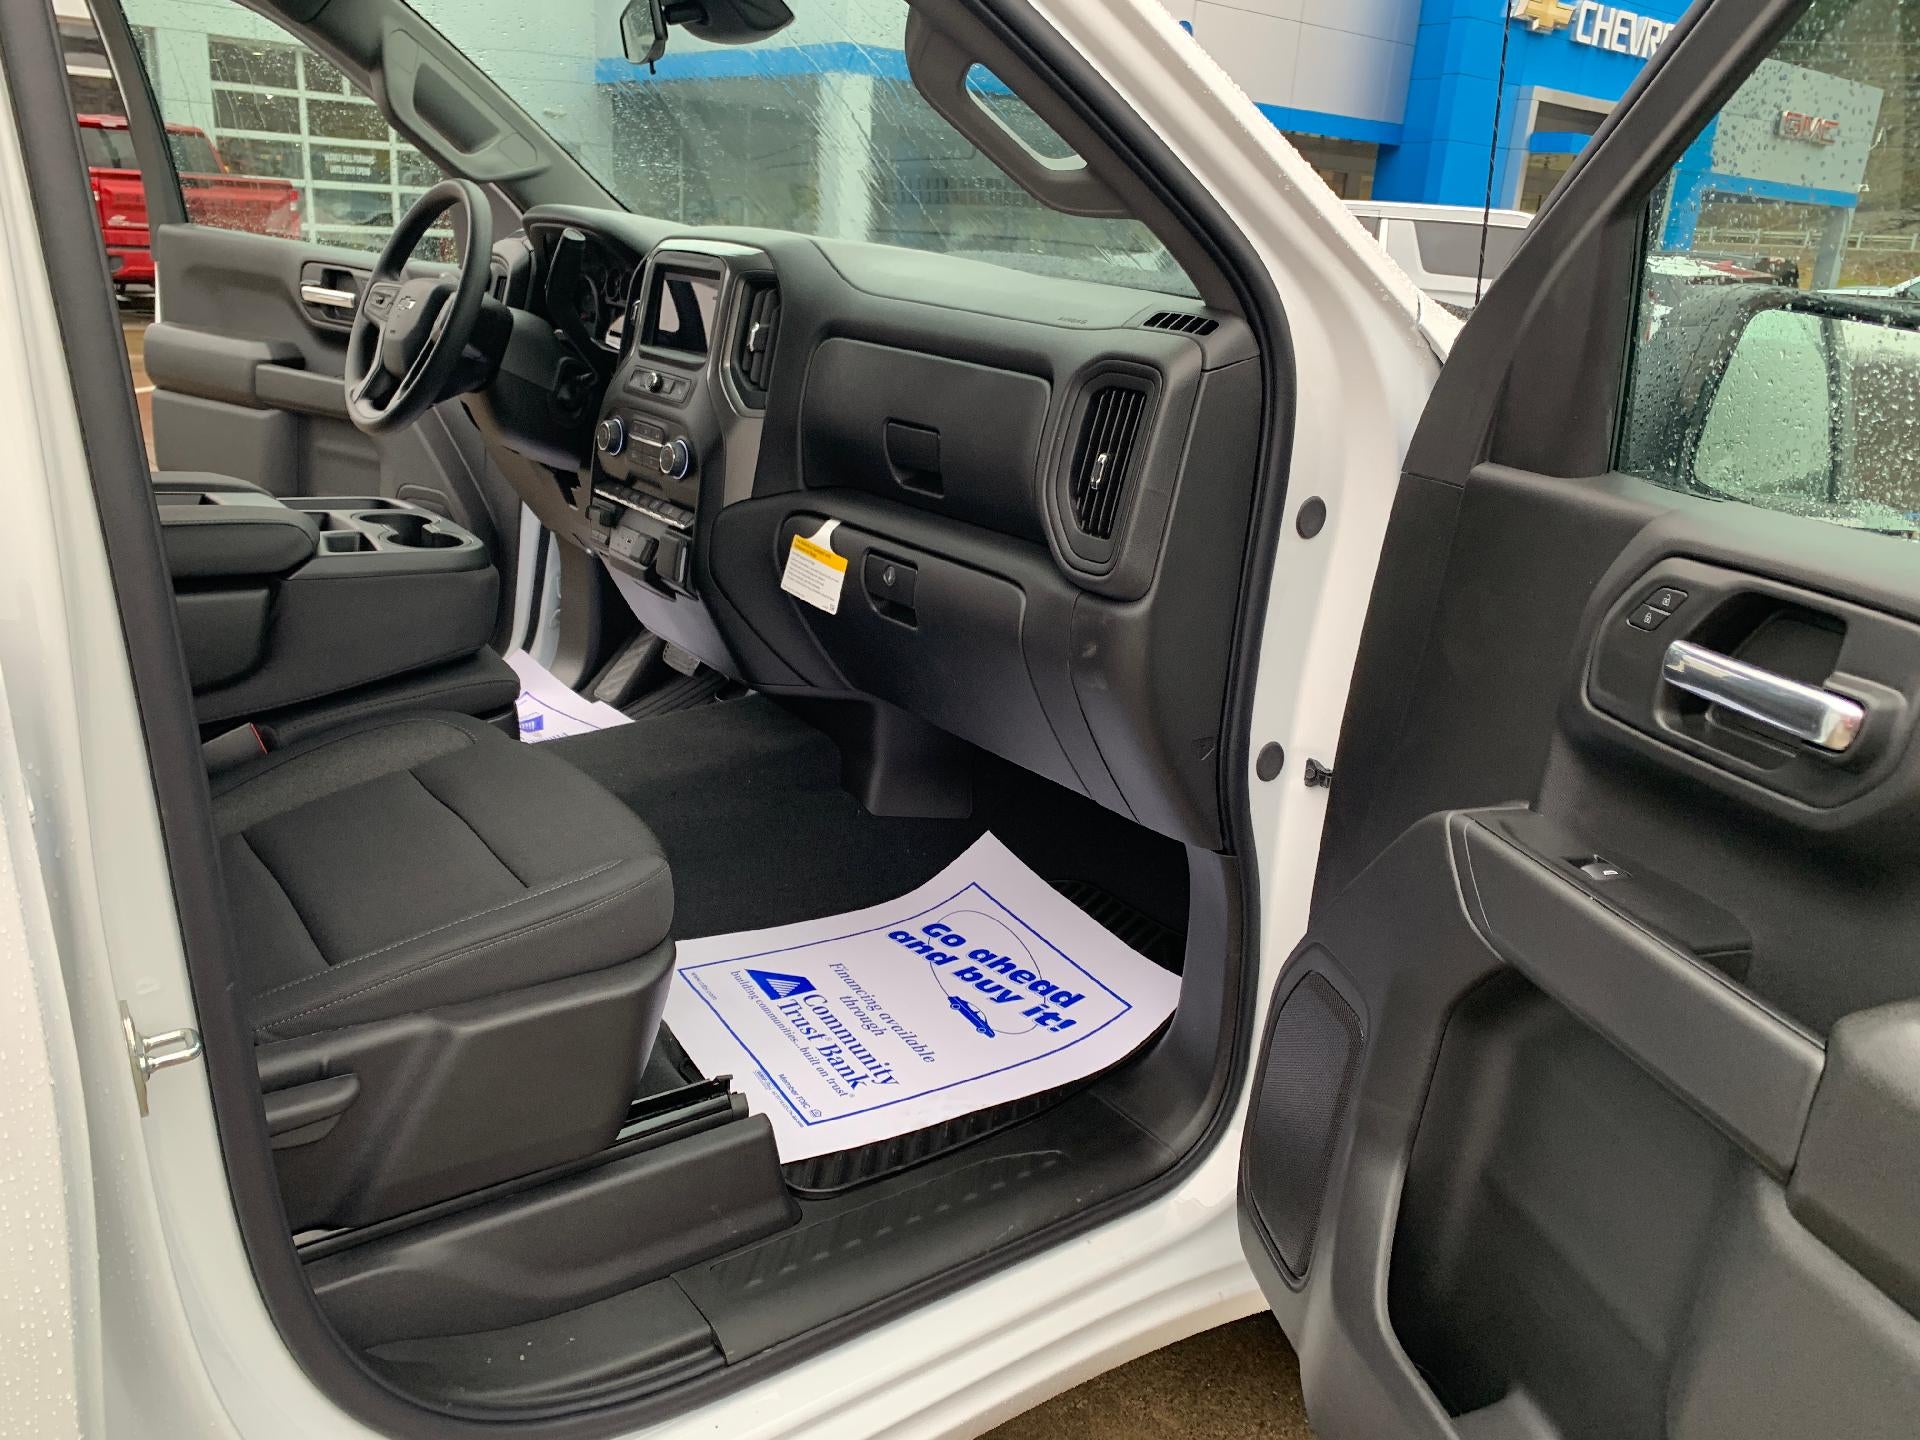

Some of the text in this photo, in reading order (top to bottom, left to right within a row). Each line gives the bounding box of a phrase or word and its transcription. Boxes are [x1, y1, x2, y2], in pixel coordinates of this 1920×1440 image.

[1780, 111, 1840, 145] GMC
[887, 930, 1078, 1033] and buy it!
[921, 923, 1086, 1009] Go ahead
[730, 970, 760, 1000] building
[816, 1066, 828, 1078] on
[803, 993, 900, 1086] Community
[829, 962, 936, 1064] Financing available
[839, 995, 886, 1037] through
[777, 1073, 799, 1096] Member
[796, 1095, 811, 1109] FDIC
[816, 1043, 868, 1090] Bank
